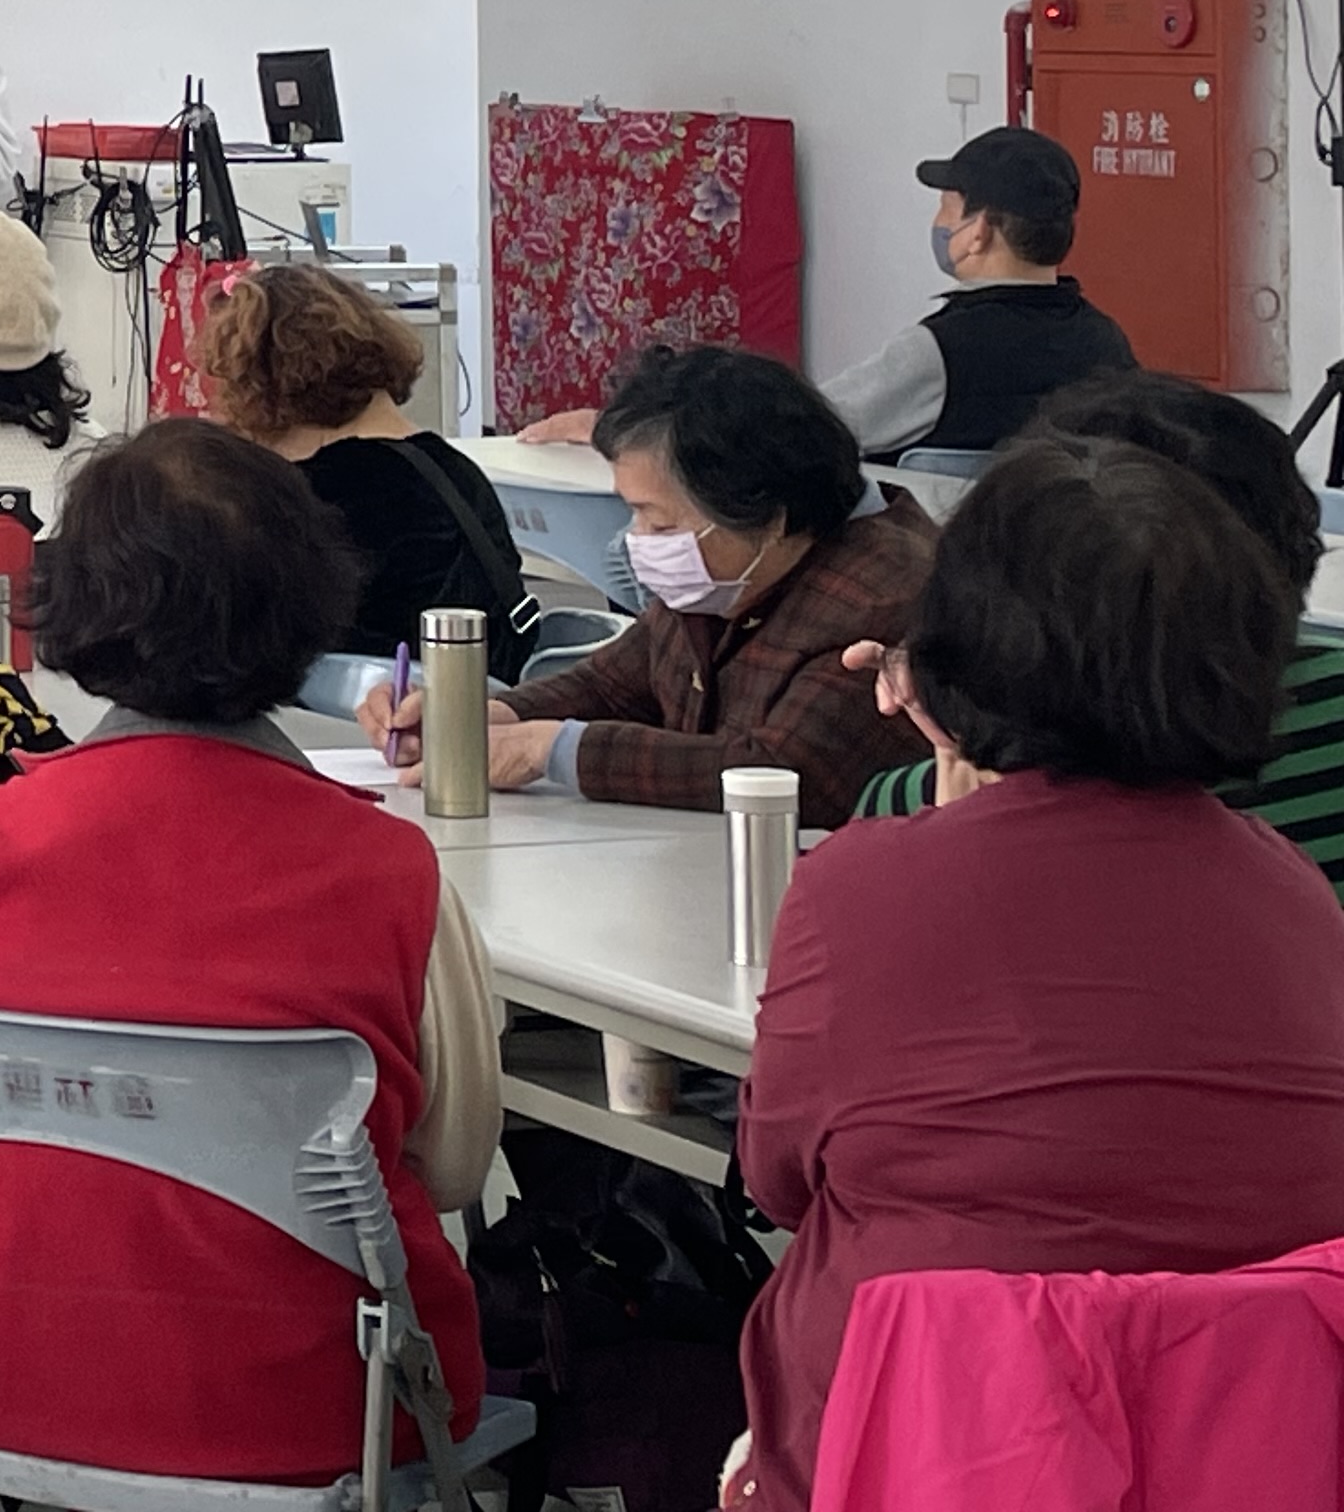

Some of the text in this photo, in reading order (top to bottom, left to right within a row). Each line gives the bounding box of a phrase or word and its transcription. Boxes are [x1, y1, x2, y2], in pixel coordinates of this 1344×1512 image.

[1101, 109, 1170, 144] 消防栓
[1092, 145, 1119, 176] FIRE
